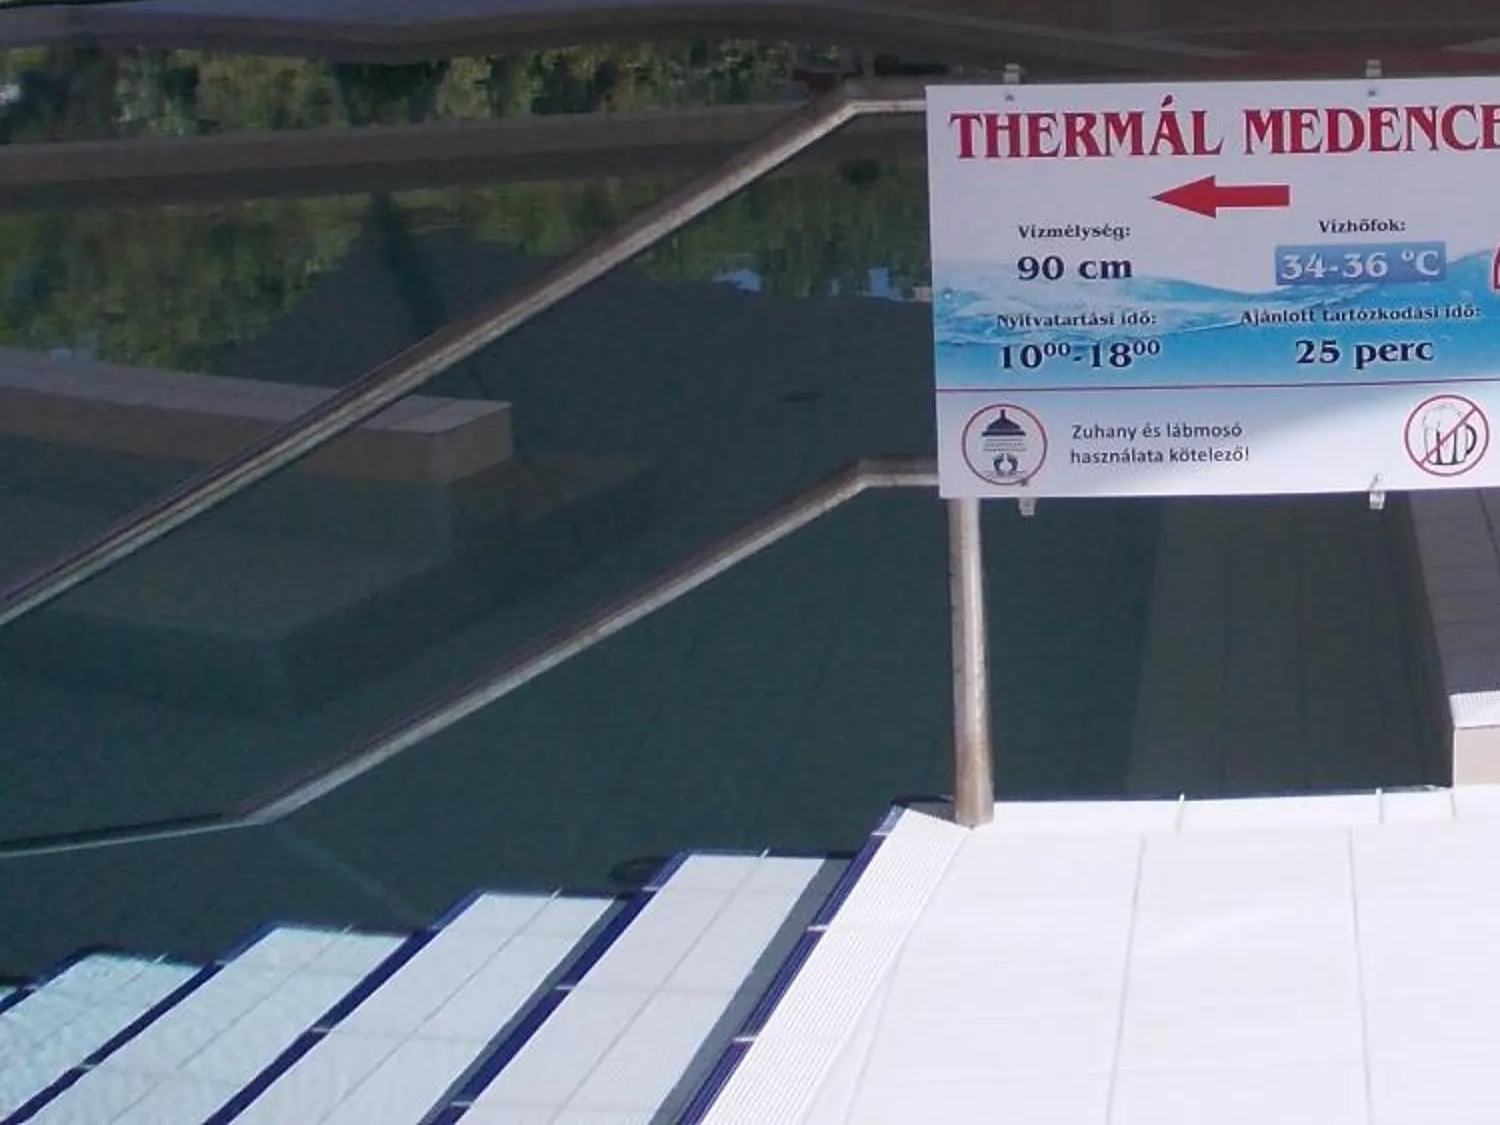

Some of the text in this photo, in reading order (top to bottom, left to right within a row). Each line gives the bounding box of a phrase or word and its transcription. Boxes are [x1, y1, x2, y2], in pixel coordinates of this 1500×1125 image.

[948, 94, 1225, 159] THERMÁL
[1017, 255, 1133, 281] 90 cm
[1281, 250, 1388, 280] 34-36
[996, 310, 1157, 331] Nyitvatartási idő:
[1239, 304, 1482, 327] Ajánlott tartózkodási idő:
[1295, 339, 1435, 370] 25 perc
[1072, 421, 1242, 442] Zuhany és lábmosó
[1070, 446, 1249, 464] használata kötelező!
